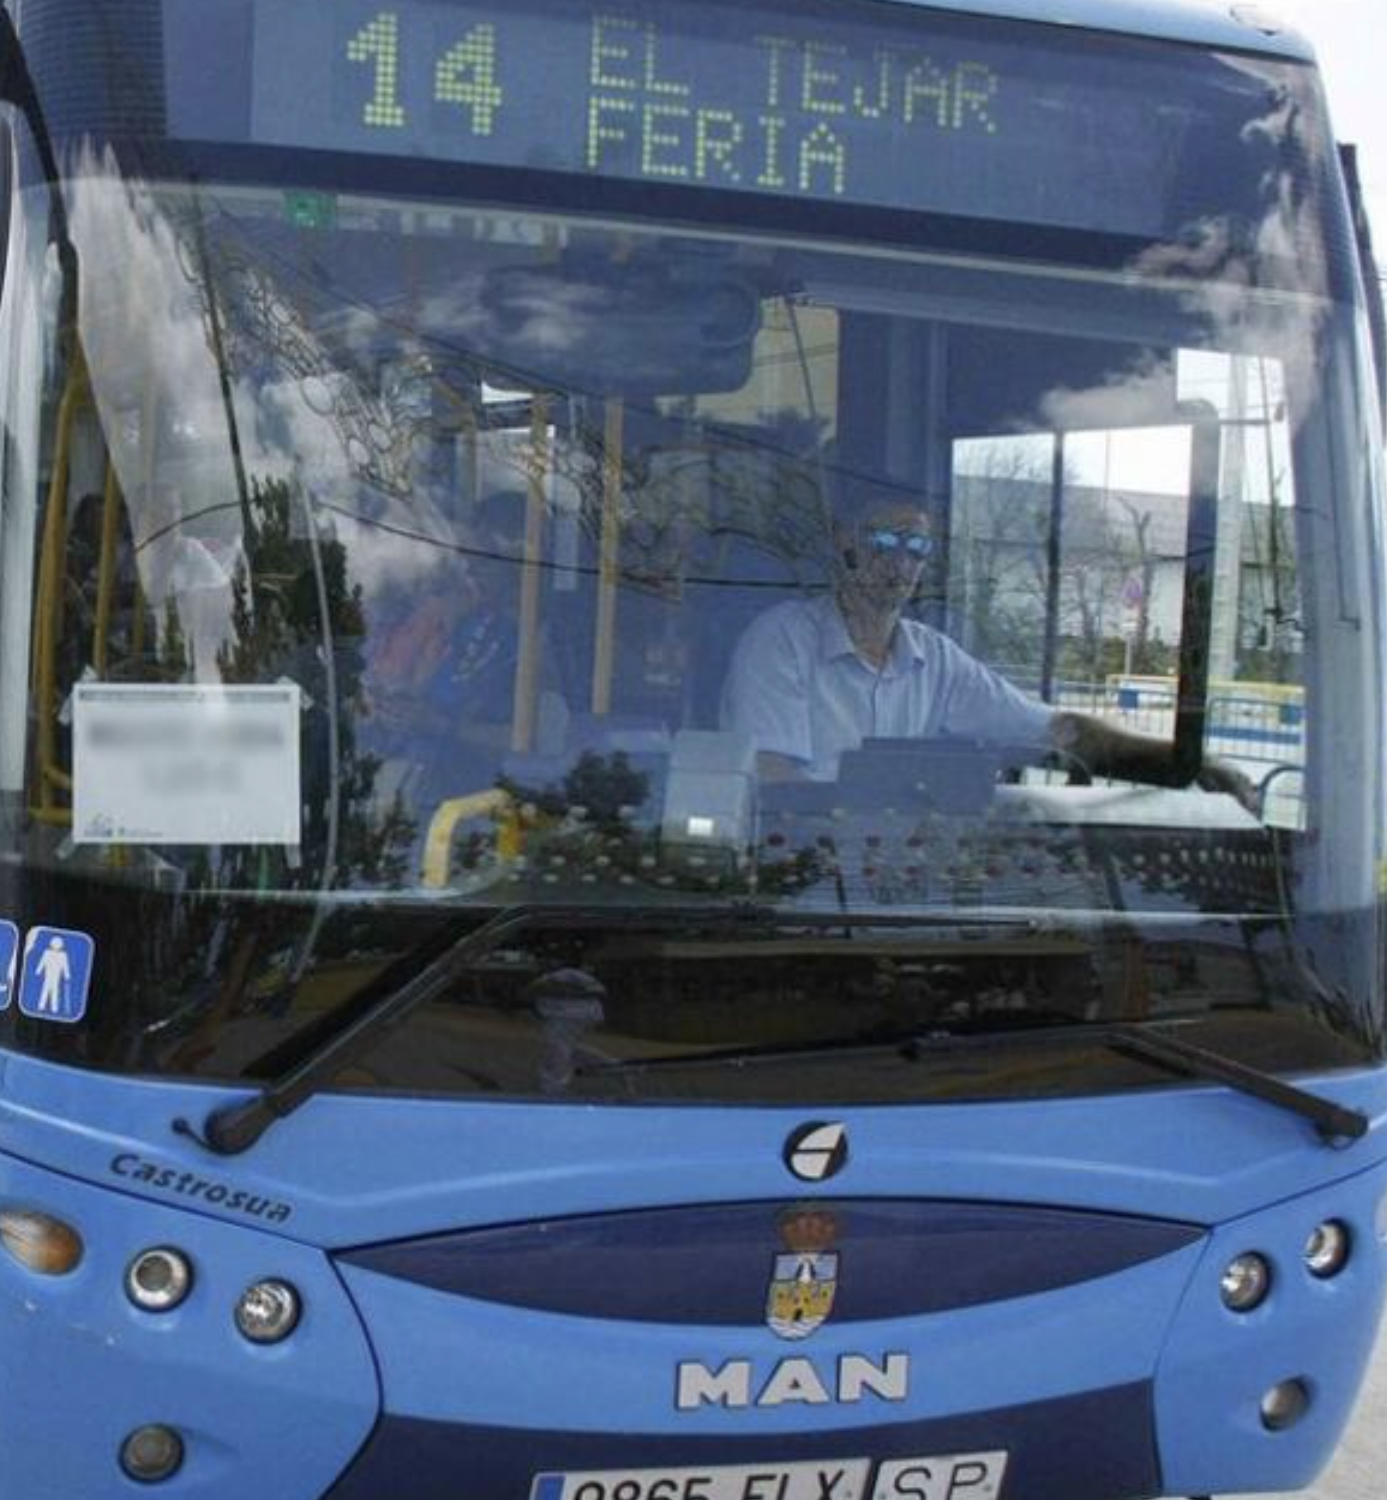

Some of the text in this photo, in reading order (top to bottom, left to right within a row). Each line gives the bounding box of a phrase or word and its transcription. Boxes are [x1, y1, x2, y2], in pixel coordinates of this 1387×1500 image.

[346, 13, 503, 136] 14
[589, 15, 999, 133] EL TEJAR
[587, 97, 845, 194] FERIA
[109, 1152, 293, 1222] Castrosua
[674, 1353, 910, 1410] MAN
